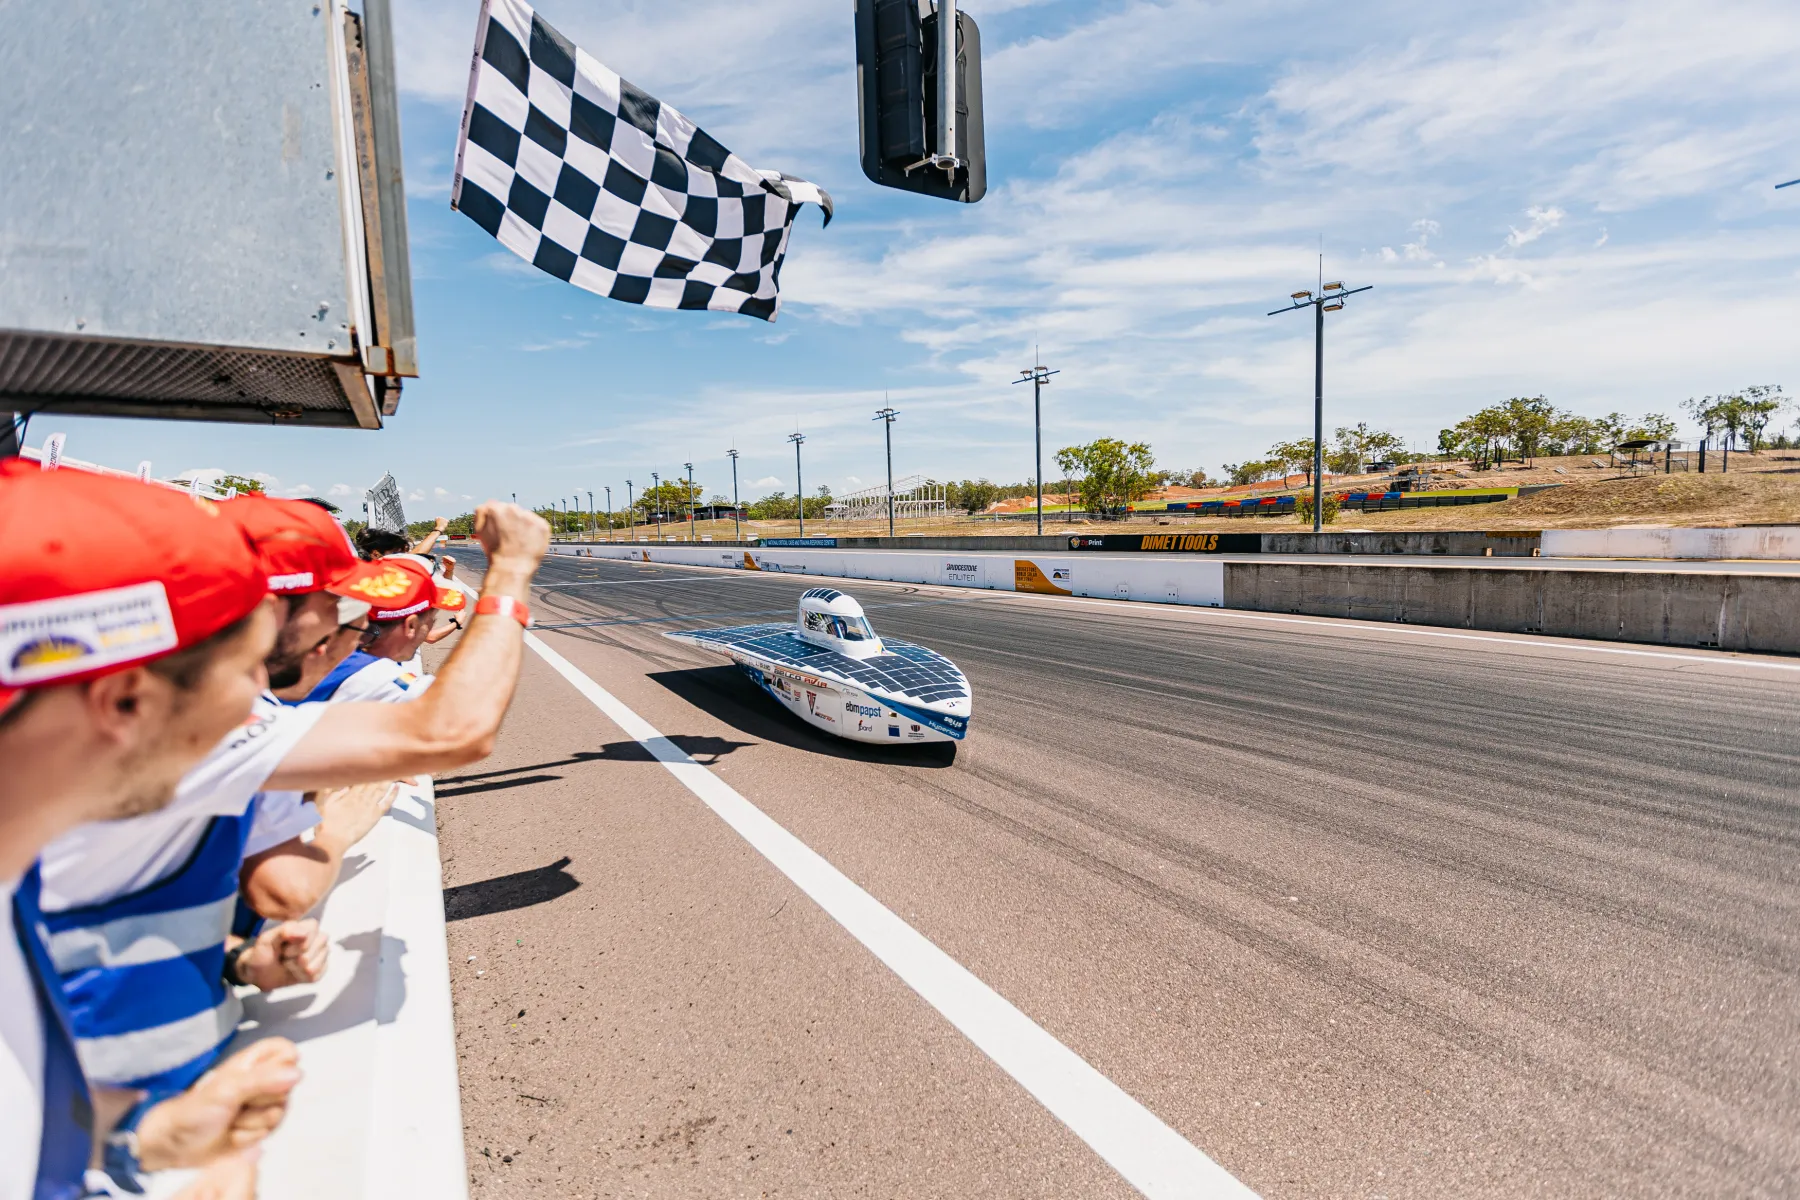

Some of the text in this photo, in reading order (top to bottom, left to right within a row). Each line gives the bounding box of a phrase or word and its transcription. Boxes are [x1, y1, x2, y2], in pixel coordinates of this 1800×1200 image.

[1141, 534, 1219, 550] DIMET TOOLS
[946, 563, 978, 572] BRIDGESTONE
[948, 573, 976, 582] ENLITEN
[845, 701, 882, 718] ebmpapst
[928, 720, 960, 738] Hyperion
